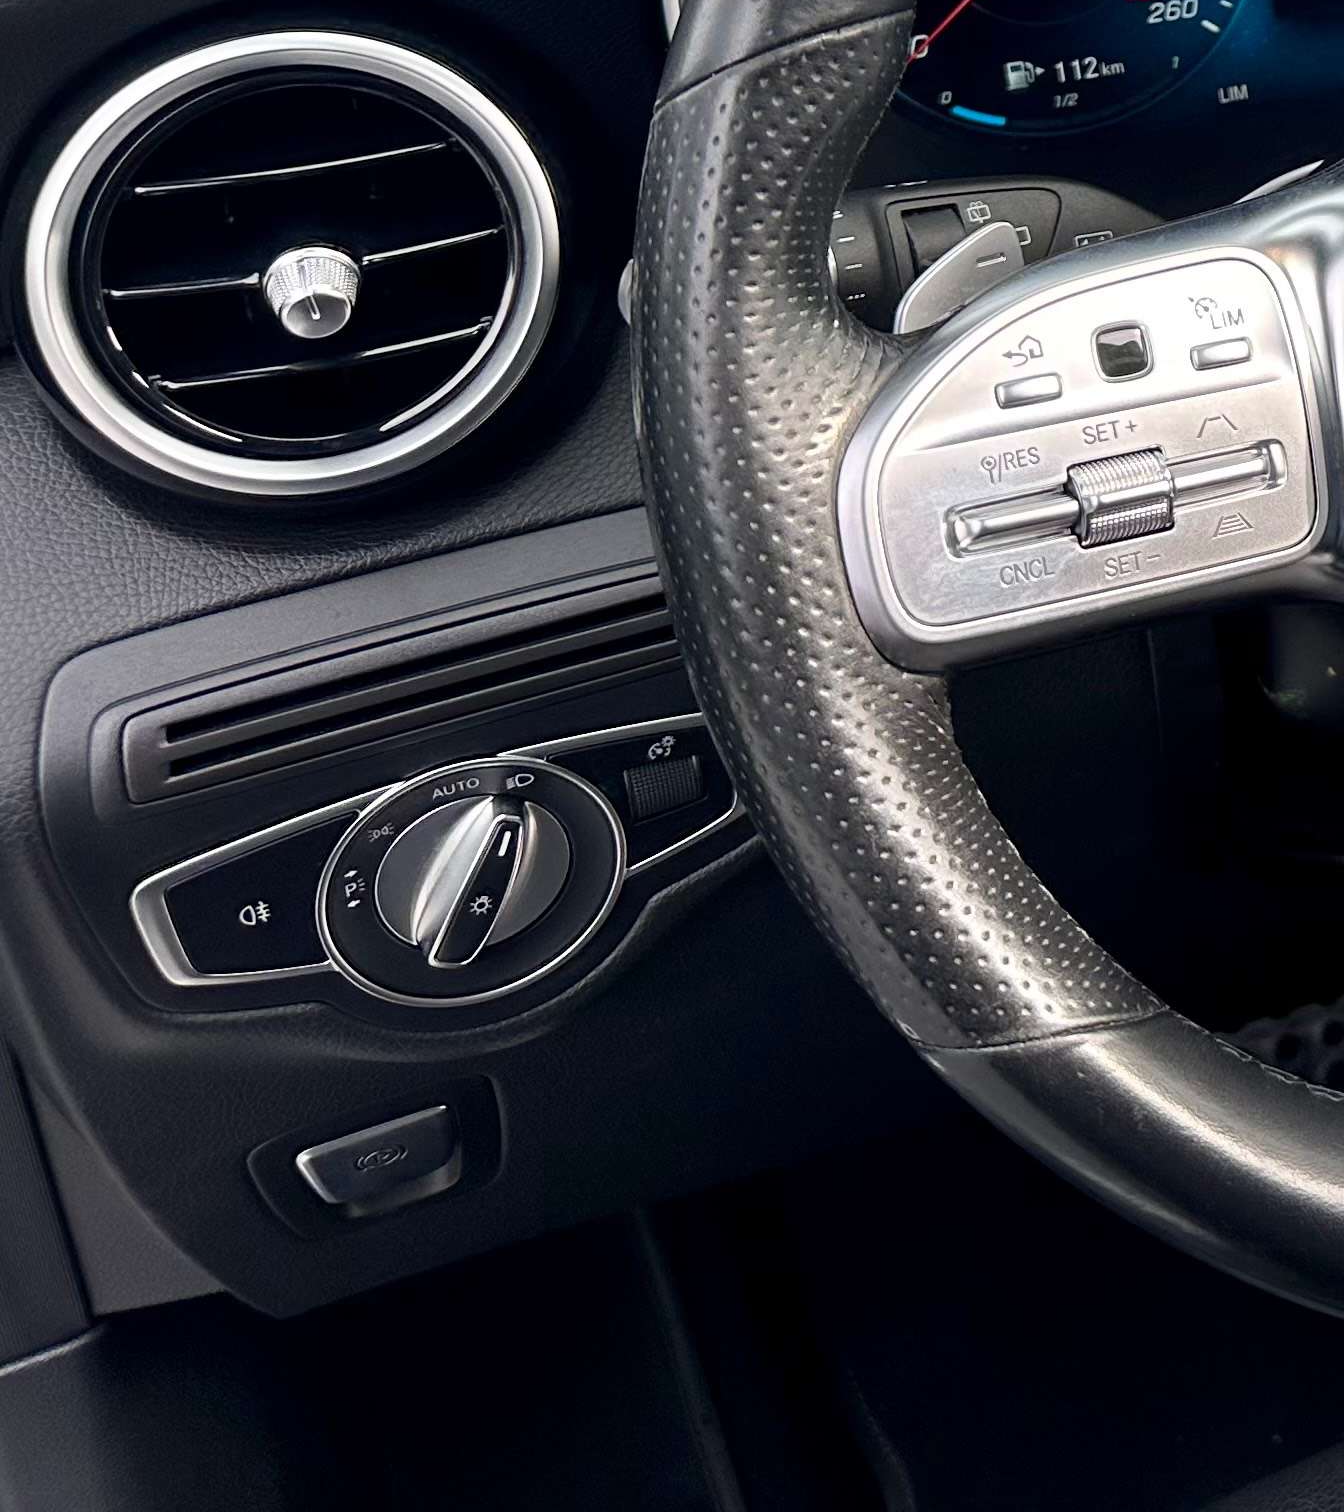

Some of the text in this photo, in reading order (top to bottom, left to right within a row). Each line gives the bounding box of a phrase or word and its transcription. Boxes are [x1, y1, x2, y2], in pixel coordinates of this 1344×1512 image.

[1054, 56, 1126, 83] 112 km
[1217, 83, 1249, 104] LIM
[1210, 307, 1245, 330] LIM
[999, 556, 1056, 587] CNCL
[431, 776, 481, 800] AUTO
